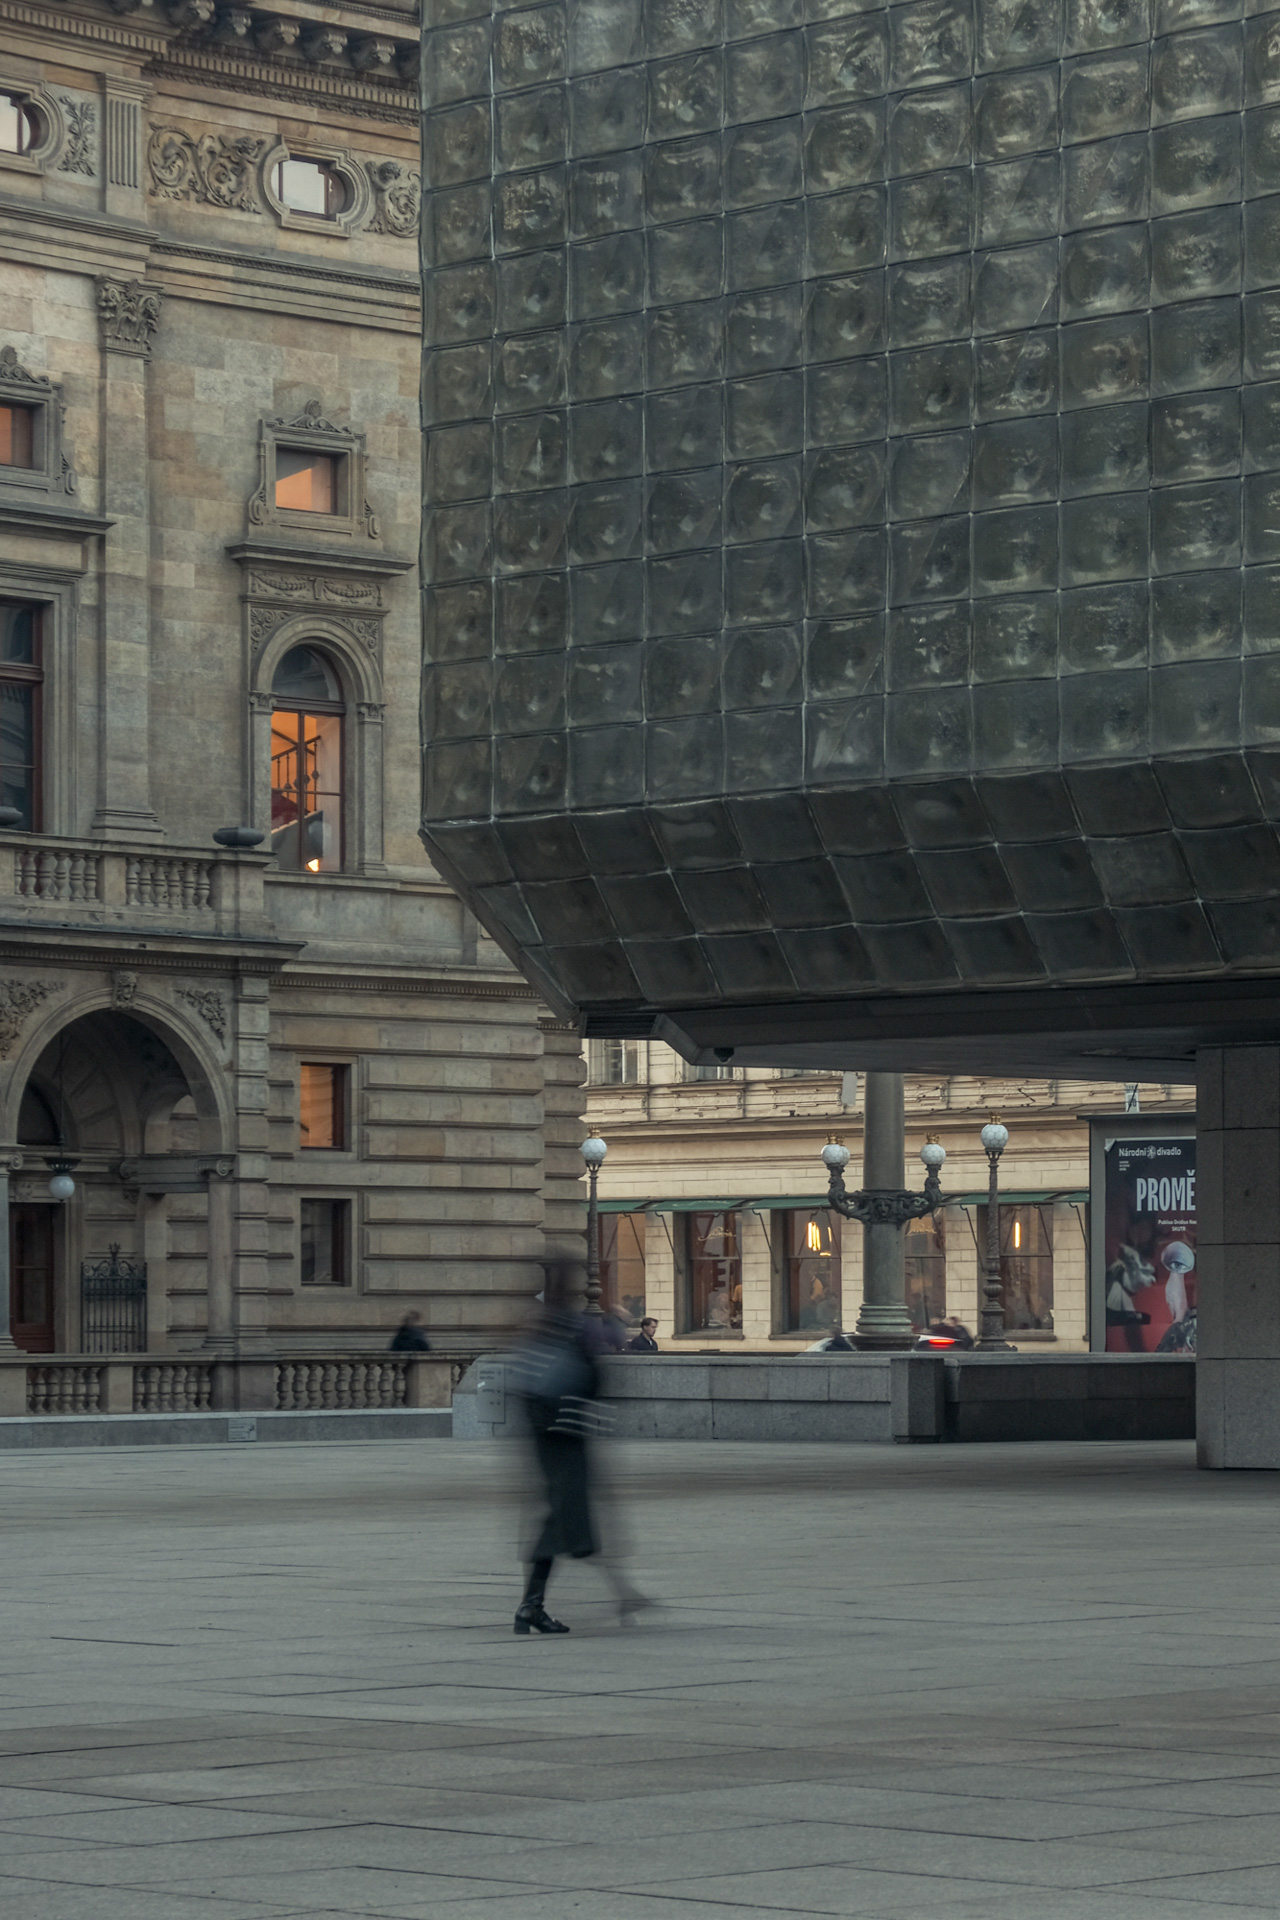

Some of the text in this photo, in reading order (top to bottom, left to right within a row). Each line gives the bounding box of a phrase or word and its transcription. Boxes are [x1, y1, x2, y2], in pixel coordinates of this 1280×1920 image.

[1118, 1146, 1182, 1157] Národní divadlo
[1136, 1169, 1196, 1212] PROMĚ
